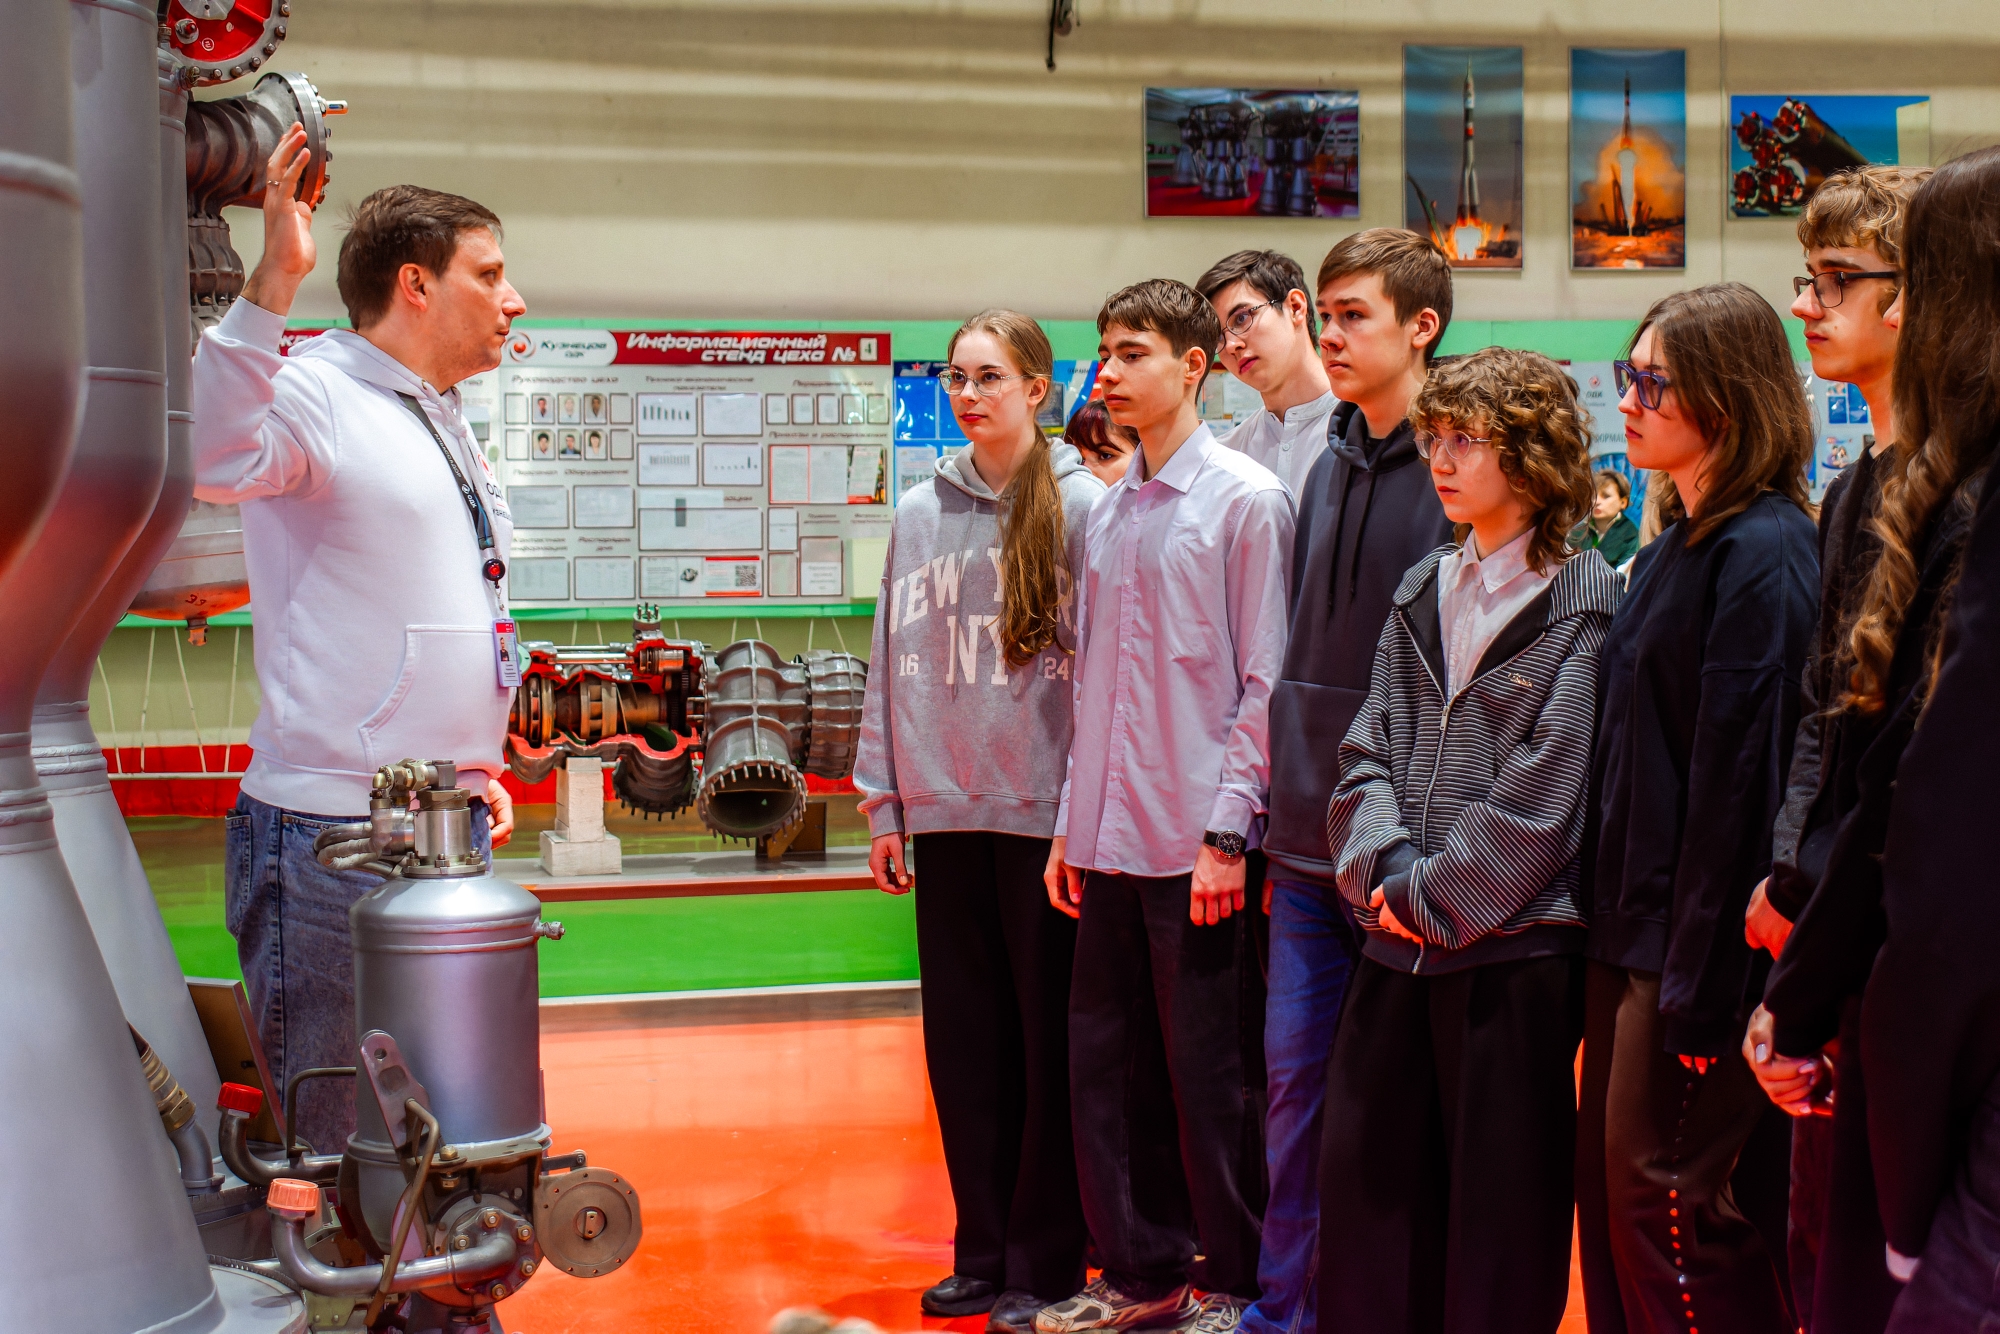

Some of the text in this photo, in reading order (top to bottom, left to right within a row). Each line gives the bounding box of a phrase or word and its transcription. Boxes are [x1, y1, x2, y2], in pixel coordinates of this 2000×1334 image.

[626, 333, 827, 352] Информационный
[701, 350, 767, 364] стенд
[773, 349, 826, 364] цеха
[832, 347, 857, 362] №
[946, 614, 1009, 686] NY
[899, 653, 920, 677] 16
[1044, 656, 1070, 681] 24
